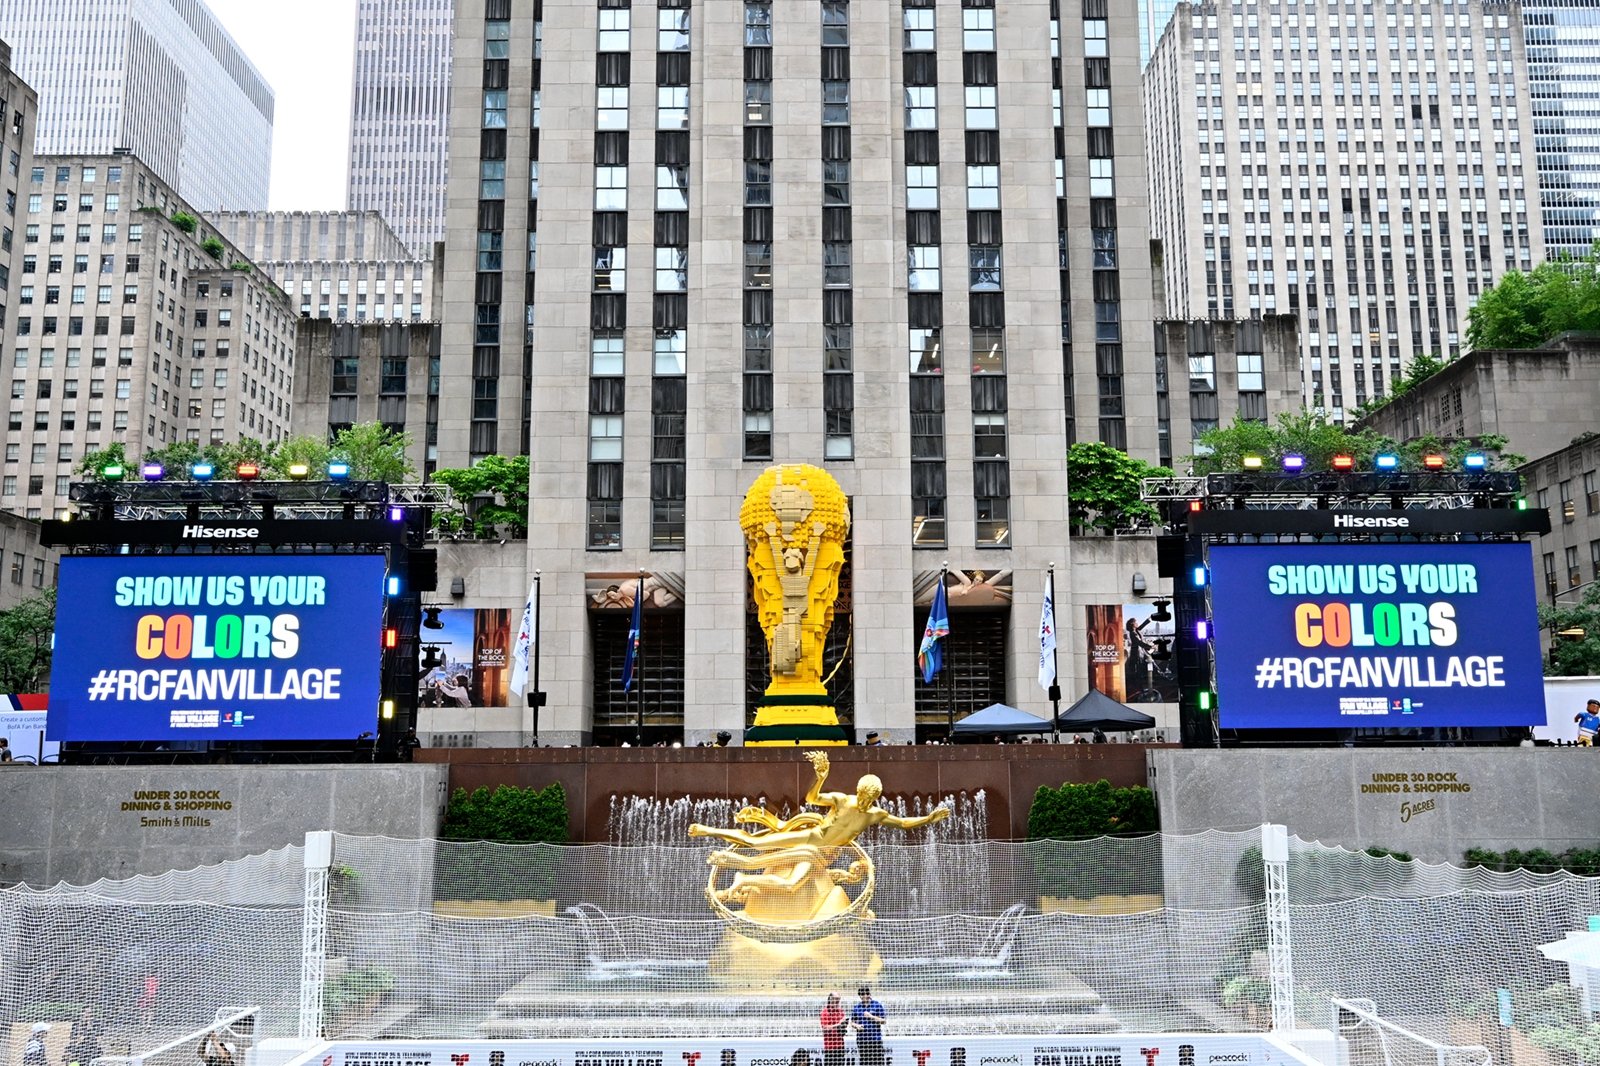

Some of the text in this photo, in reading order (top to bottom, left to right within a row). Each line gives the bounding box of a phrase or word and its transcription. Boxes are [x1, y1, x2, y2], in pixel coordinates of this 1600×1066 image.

[1333, 514, 1410, 528] Hisense
[182, 525, 259, 538] Hisense
[1268, 563, 1478, 595] SHOW US YOUR
[115, 575, 326, 606] SHOW US YOUR
[1295, 602, 1458, 648] COLORS
[136, 613, 300, 660] COLORS
[1255, 656, 1505, 689] #RCFANVILLAGE
[88, 668, 341, 701] #RCFANVILLAGE
[1372, 772, 1458, 782] UNDER 30 ROCK
[1361, 783, 1470, 793] DINING & SHOPPING
[134, 790, 220, 800] UNDER 30 ROCK
[121, 801, 232, 811] DINING & SHOPPING
[1400, 798, 1435, 823] 5 ACRES
[140, 816, 172, 827] Smith
[182, 816, 210, 827] Mills
[980, 1054, 1020, 1066] peacock
[1209, 1052, 1248, 1064] peacock
